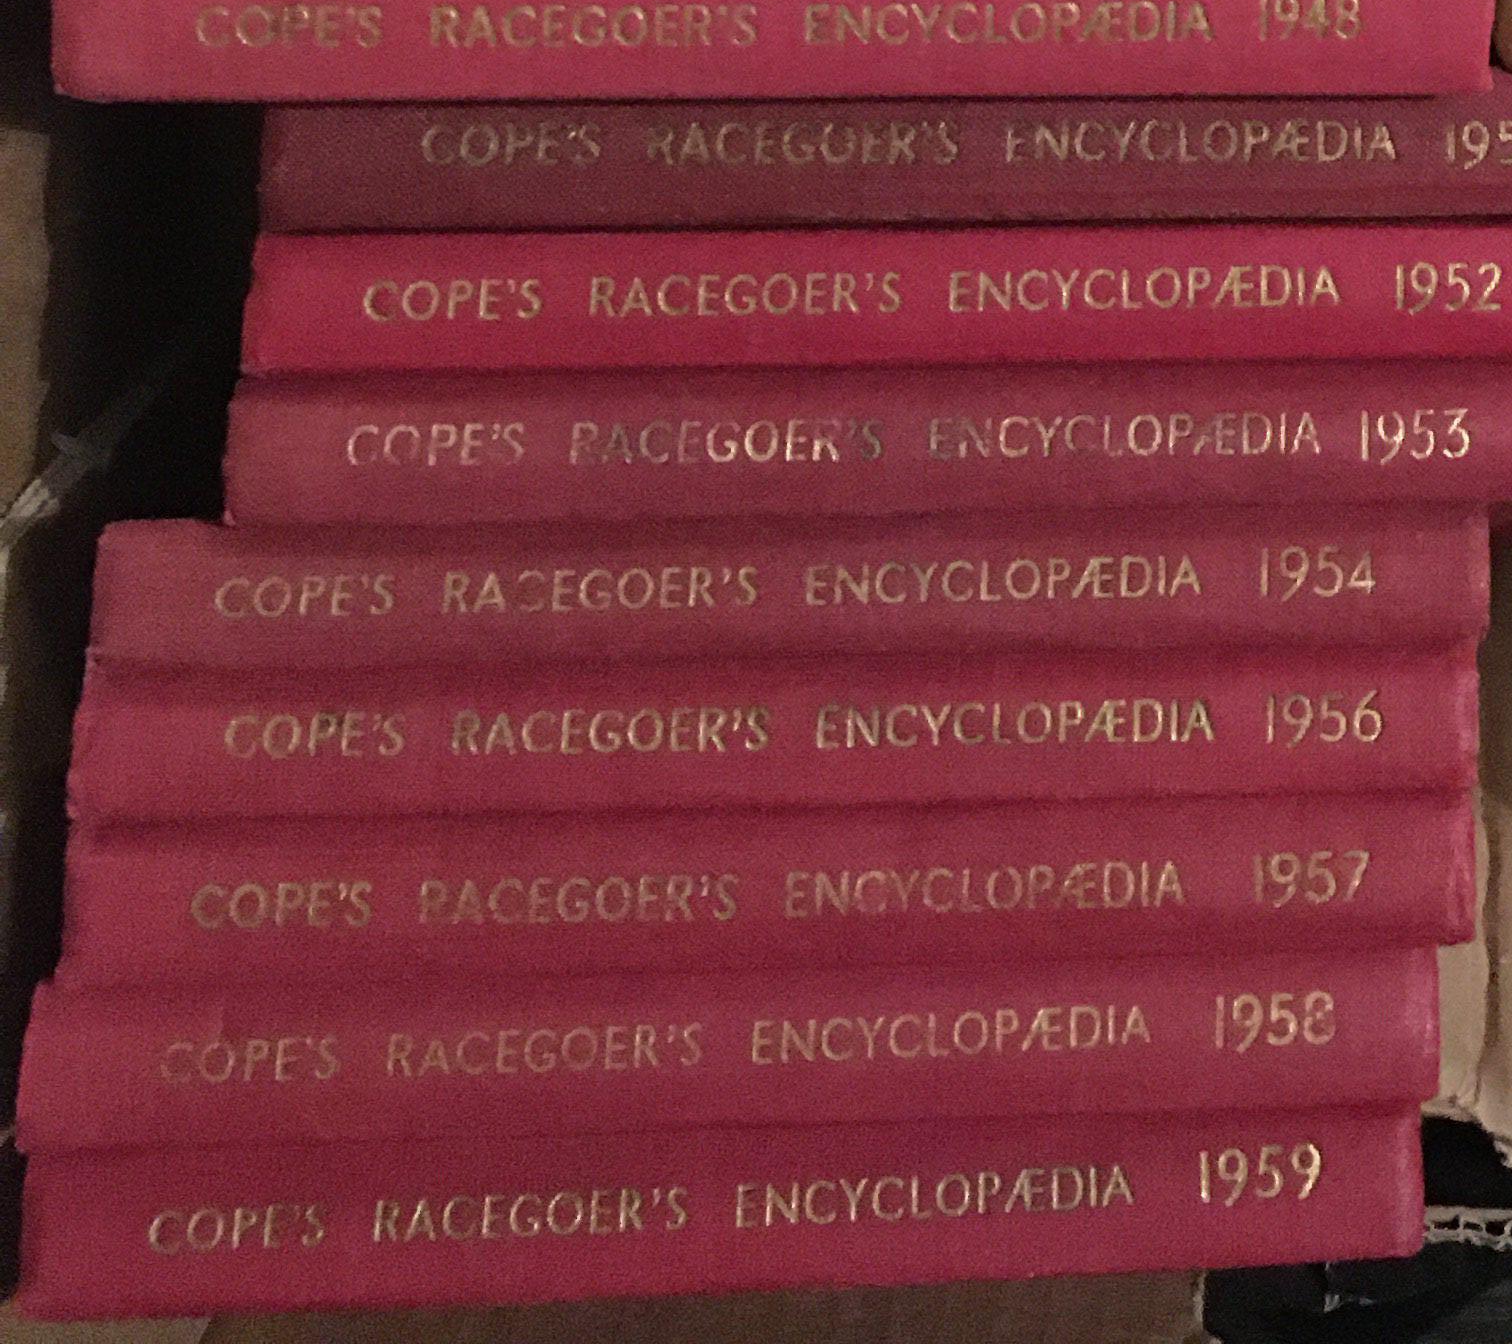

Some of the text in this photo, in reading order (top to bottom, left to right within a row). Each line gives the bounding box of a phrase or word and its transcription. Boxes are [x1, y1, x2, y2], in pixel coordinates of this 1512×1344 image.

[195, 4, 384, 49] COPE'S
[429, 4, 759, 49] RACEGOER'S
[420, 123, 602, 168] COPE'S
[648, 122, 958, 167] RACEGOER'S
[363, 278, 544, 323] COPE'S
[589, 271, 902, 319] RACEGOER'S
[1396, 262, 1504, 316] 1952
[347, 423, 527, 469] COPE'S
[569, 418, 884, 466] RACEGOER'S
[1360, 407, 1473, 465] 1953
[214, 575, 395, 618] COPE'S
[442, 567, 760, 615] RACEGOER'S
[1259, 545, 1376, 601] 1954
[224, 713, 406, 761] COPE'S
[451, 706, 772, 756] RACEGOER'S
[1266, 689, 1383, 745] 1956
[190, 880, 373, 930] COPE'S
[419, 874, 738, 927] RACEGOER'S
[1254, 850, 1371, 908] 1957
[160, 1037, 341, 1086] COPE'S
[386, 1023, 705, 1077] RACEGOER'S
[1215, 991, 1335, 1053] 1958
[149, 1202, 326, 1256] COPE'S
[372, 1186, 690, 1244] RACEGOER'S
[1199, 1142, 1322, 1204] 1959
